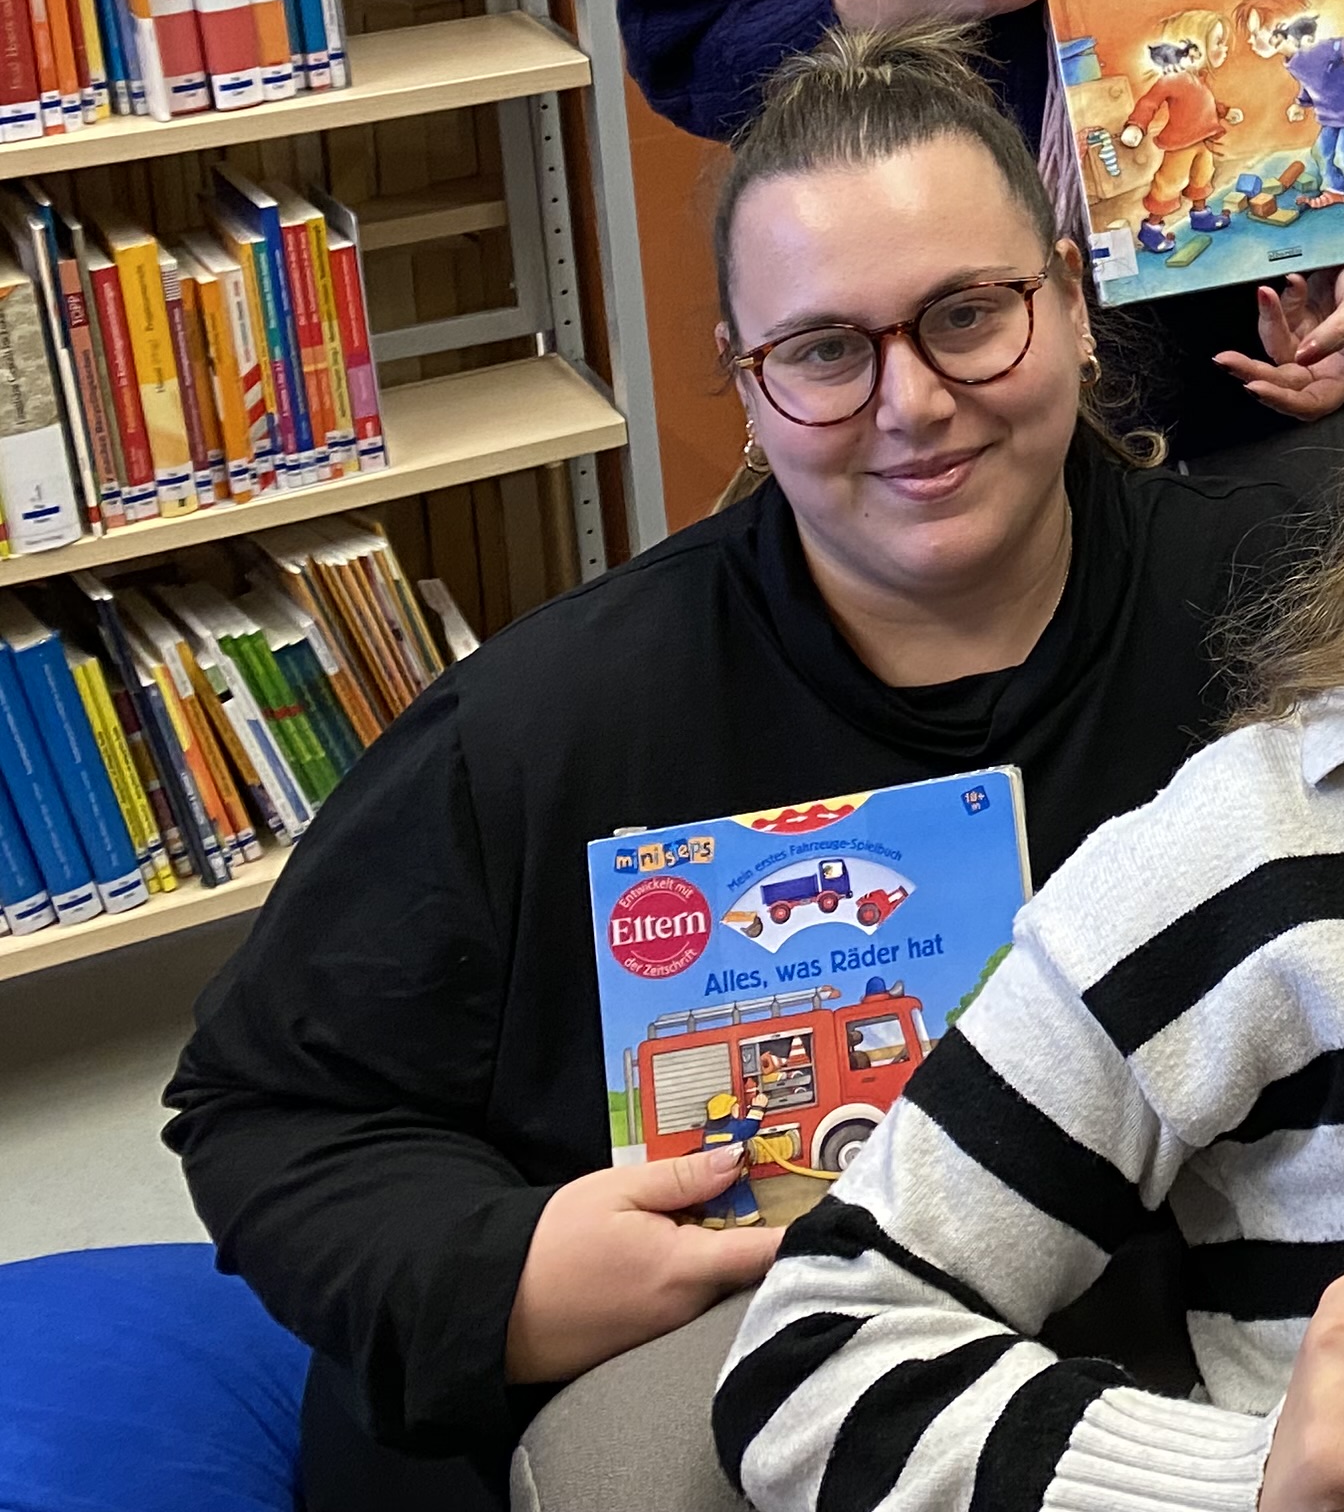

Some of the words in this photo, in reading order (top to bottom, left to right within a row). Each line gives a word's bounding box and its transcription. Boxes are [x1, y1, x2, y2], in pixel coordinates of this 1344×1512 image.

[66, 295, 85, 326] TOPP
[726, 867, 754, 893] Mein
[754, 851, 788, 873] erstes
[789, 837, 904, 862] Fahrzeuge-Spielbuch
[618, 877, 673, 910] Entwickelt
[674, 881, 695, 899] mit
[610, 908, 707, 947] Eltern
[623, 957, 644, 975] der
[642, 947, 698, 977] Zeitschrift
[704, 968, 768, 998] Alles,
[775, 957, 822, 979] was
[831, 941, 900, 974] Räder
[907, 933, 945, 960] hat
